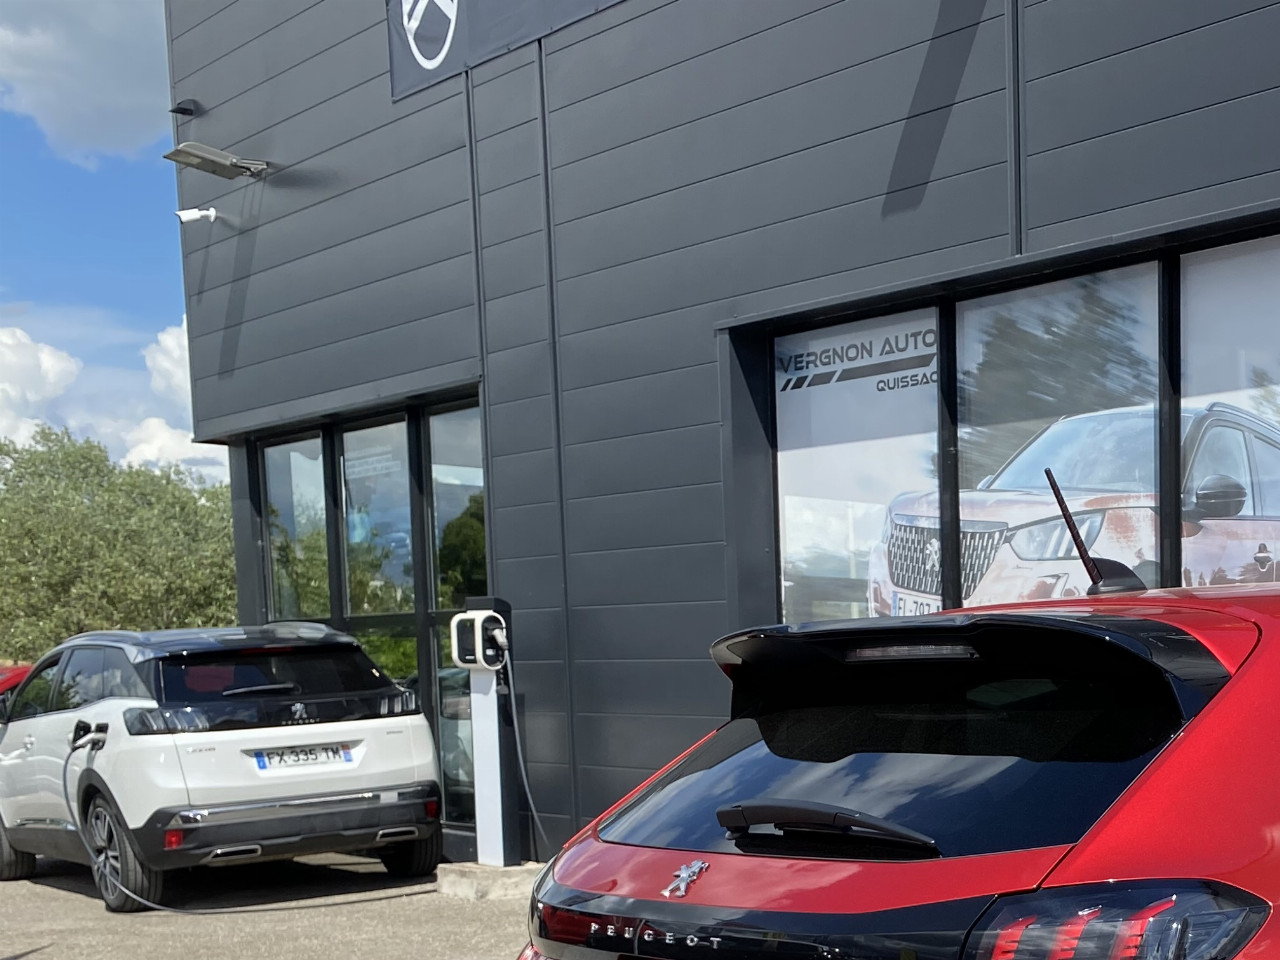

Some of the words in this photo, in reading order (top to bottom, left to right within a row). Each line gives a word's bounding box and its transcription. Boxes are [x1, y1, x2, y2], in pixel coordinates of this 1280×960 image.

[778, 341, 873, 374] VERGNON
[880, 328, 937, 356] AUTO
[590, 922, 722, 949] PEUGEOT
